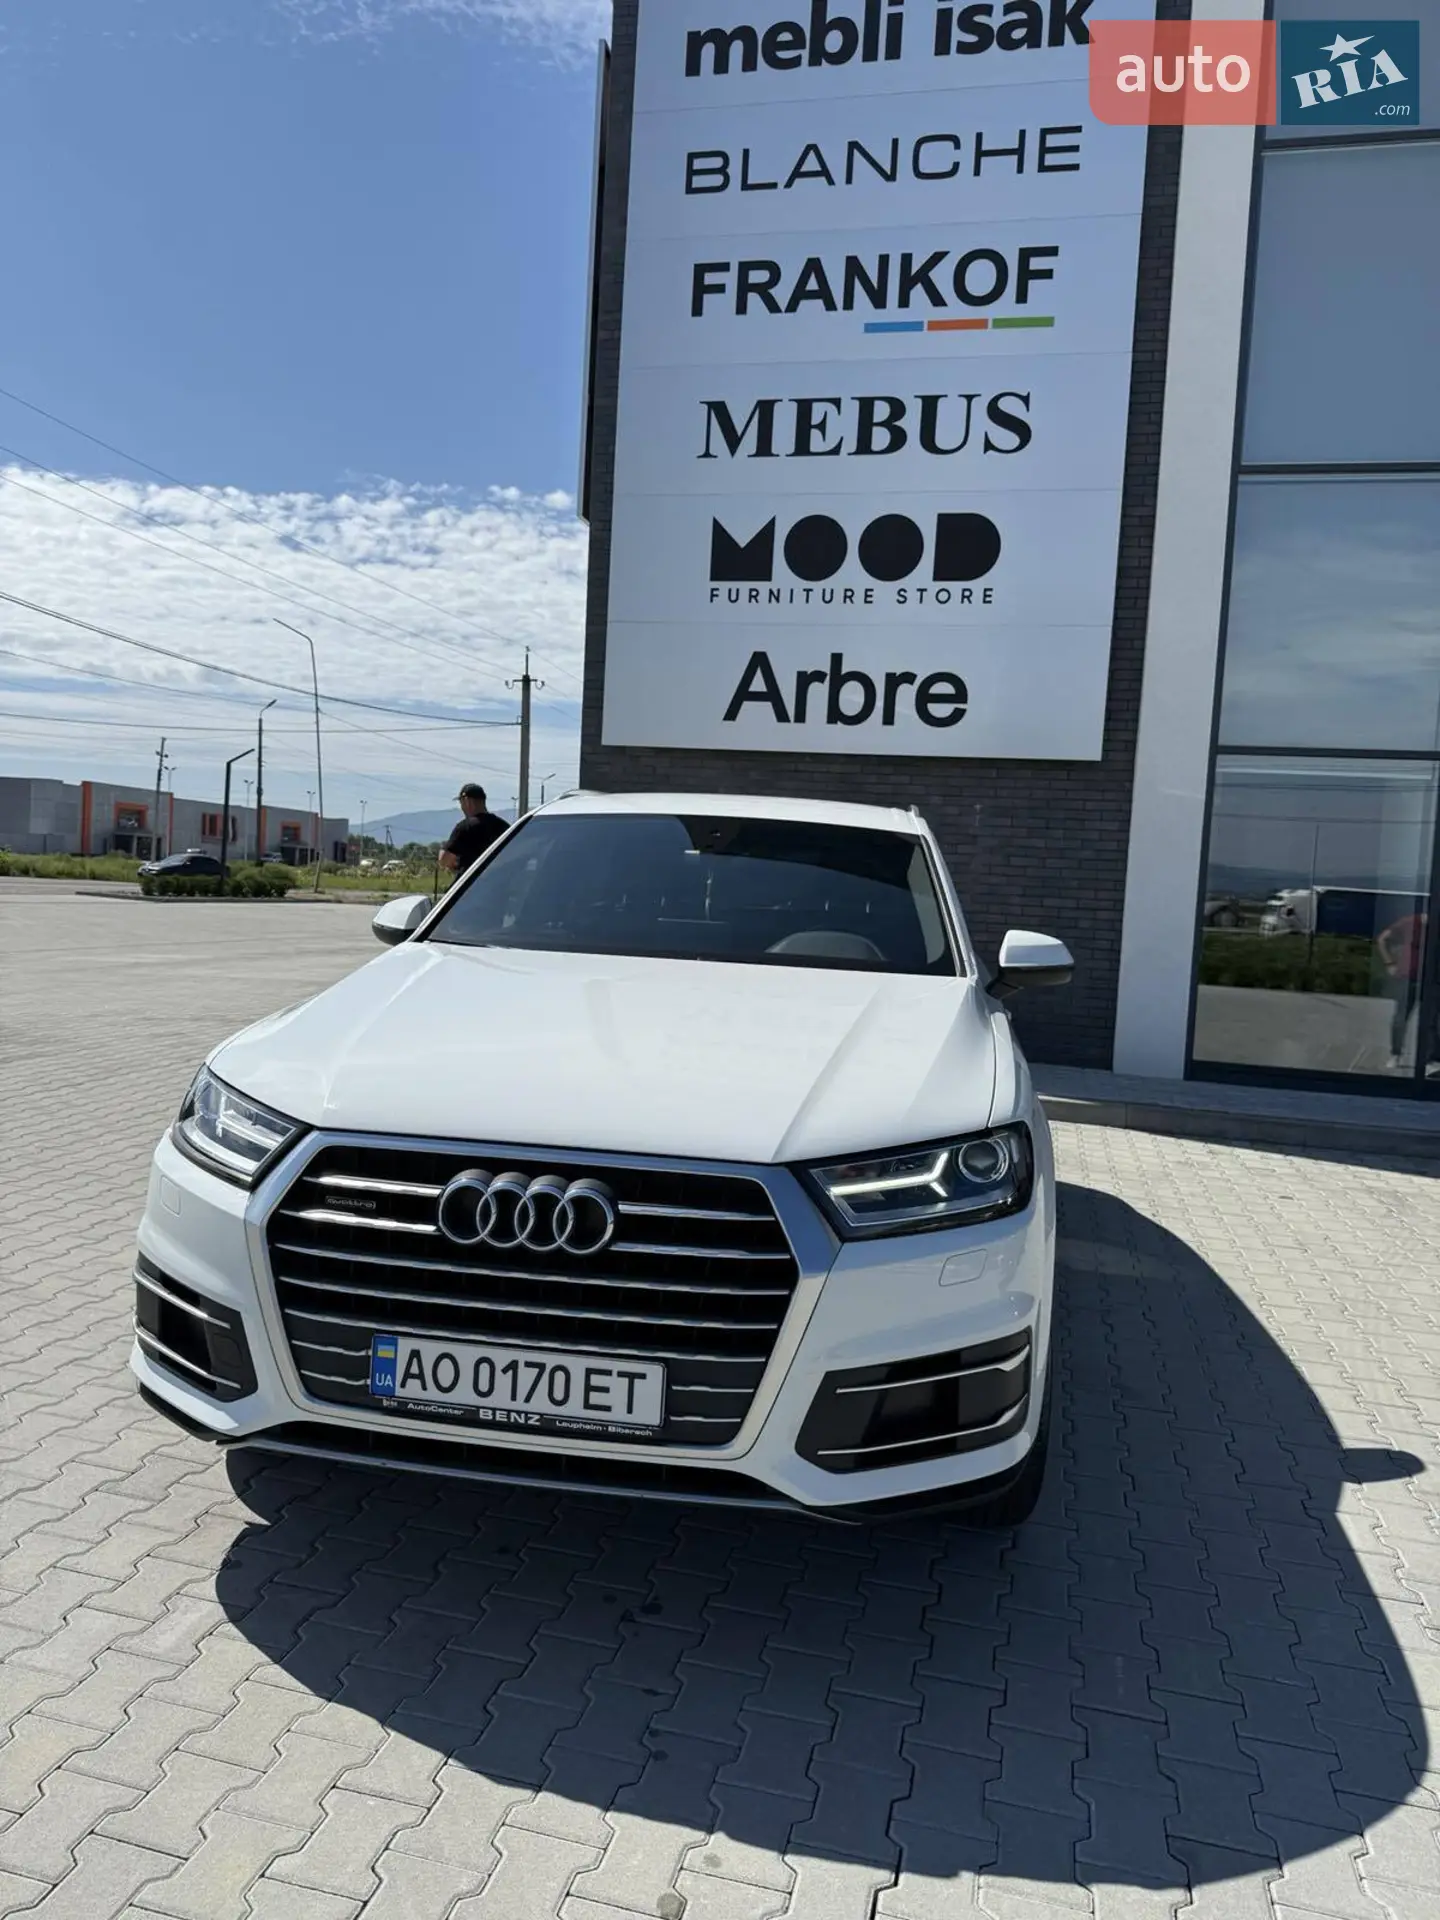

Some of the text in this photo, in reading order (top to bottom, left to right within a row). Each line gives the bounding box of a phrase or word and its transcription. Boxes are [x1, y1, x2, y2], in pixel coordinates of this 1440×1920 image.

[685, 0, 1095, 77] mebli isak
[684, 125, 1083, 195] BLANCHE
[690, 245, 1060, 318] FRANKOF
[696, 390, 1033, 459] MEBUS
[709, 512, 1002, 582] MOOD
[709, 587, 995, 605] FURNITURE STORE
[722, 650, 969, 728] Arbre
[375, 1372, 393, 1388] UA
[400, 1348, 648, 1415] AO 0170 ET
[479, 1408, 541, 1426] BENZ
